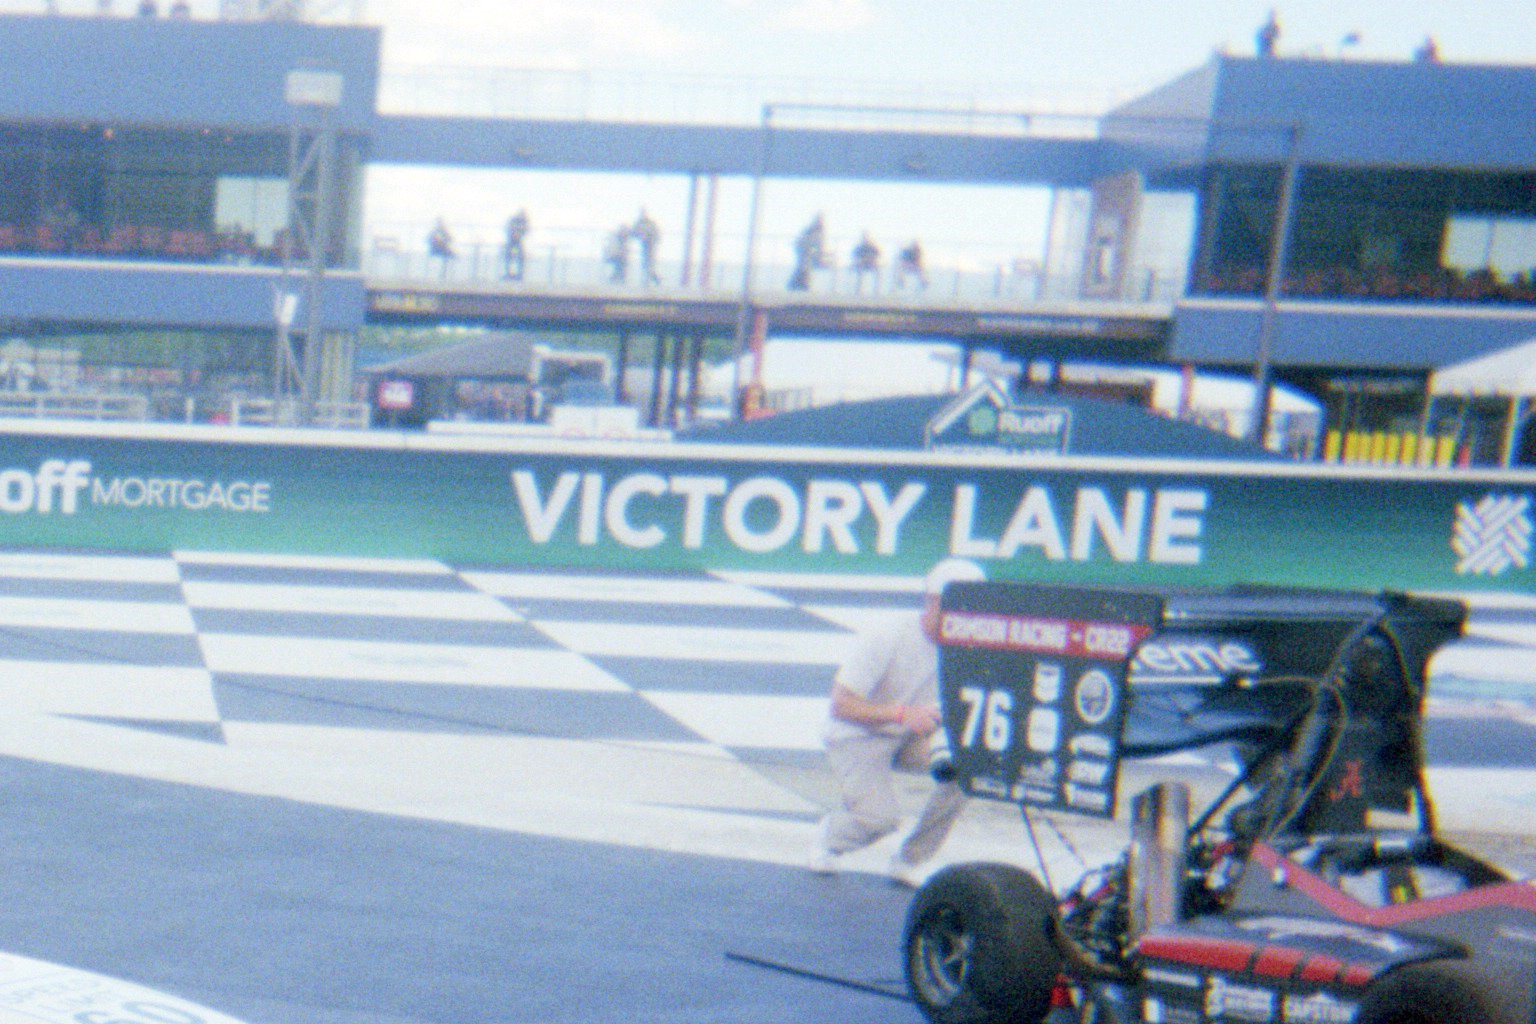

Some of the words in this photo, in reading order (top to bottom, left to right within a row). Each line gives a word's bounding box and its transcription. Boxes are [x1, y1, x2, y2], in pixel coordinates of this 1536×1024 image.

[999, 412, 1062, 434] Ruoff
[91, 476, 271, 512] MORTGAGE
[511, 470, 928, 557] VICTORY
[948, 483, 1209, 566] LANE
[960, 687, 1012, 751] 76
